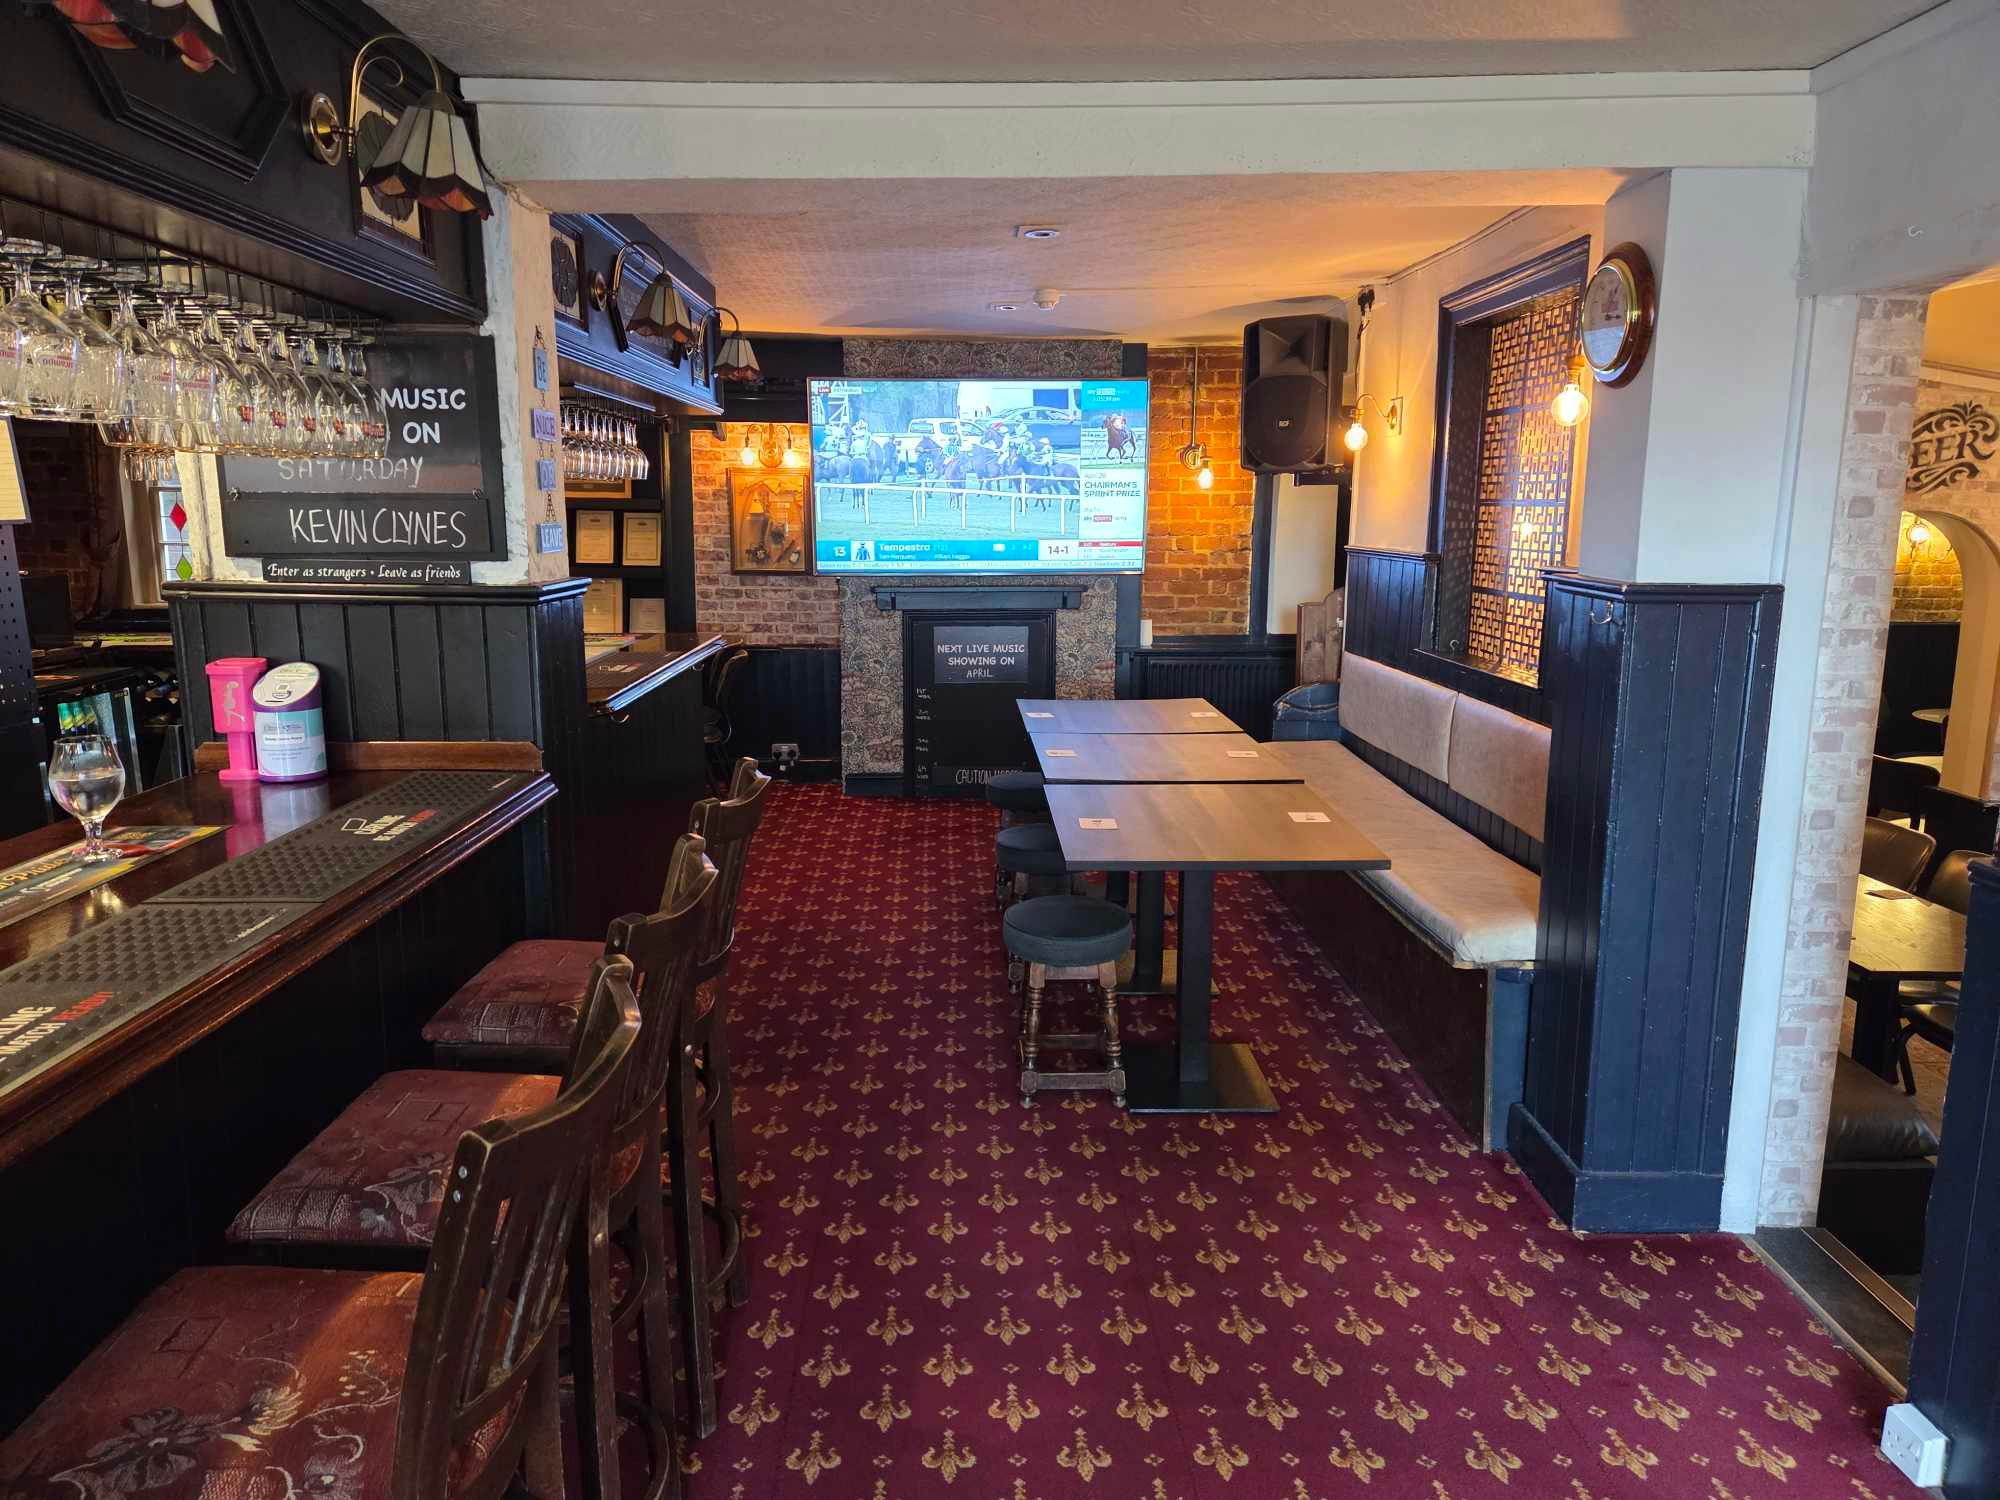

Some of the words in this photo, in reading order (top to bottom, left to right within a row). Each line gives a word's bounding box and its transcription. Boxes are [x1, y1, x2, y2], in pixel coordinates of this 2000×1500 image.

[376, 387, 467, 411] MUSIC
[402, 421, 441, 444] ON
[535, 413, 556, 438] NICE
[279, 457, 423, 489] SATURDAY
[288, 508, 367, 547] KEVIN
[372, 508, 467, 549] CLYNES
[541, 527, 563, 547] LEAVE
[267, 563, 299, 577] Enter
[302, 567, 314, 577] as
[317, 565, 373, 580] strangers
[378, 563, 408, 578] Leave
[410, 567, 423, 577] as
[425, 562, 461, 581] friends
[937, 644, 962, 653] NEXT
[966, 644, 989, 653] LIVE
[992, 644, 1025, 653] MUSIC
[947, 656, 996, 665] SHOWING
[1000, 656, 1015, 665] ON
[966, 667, 993, 678] APRIL
[955, 769, 992, 784] CAUTION
[0, 1006, 56, 1039] LING
[0, 1022, 67, 1054] MATCH
